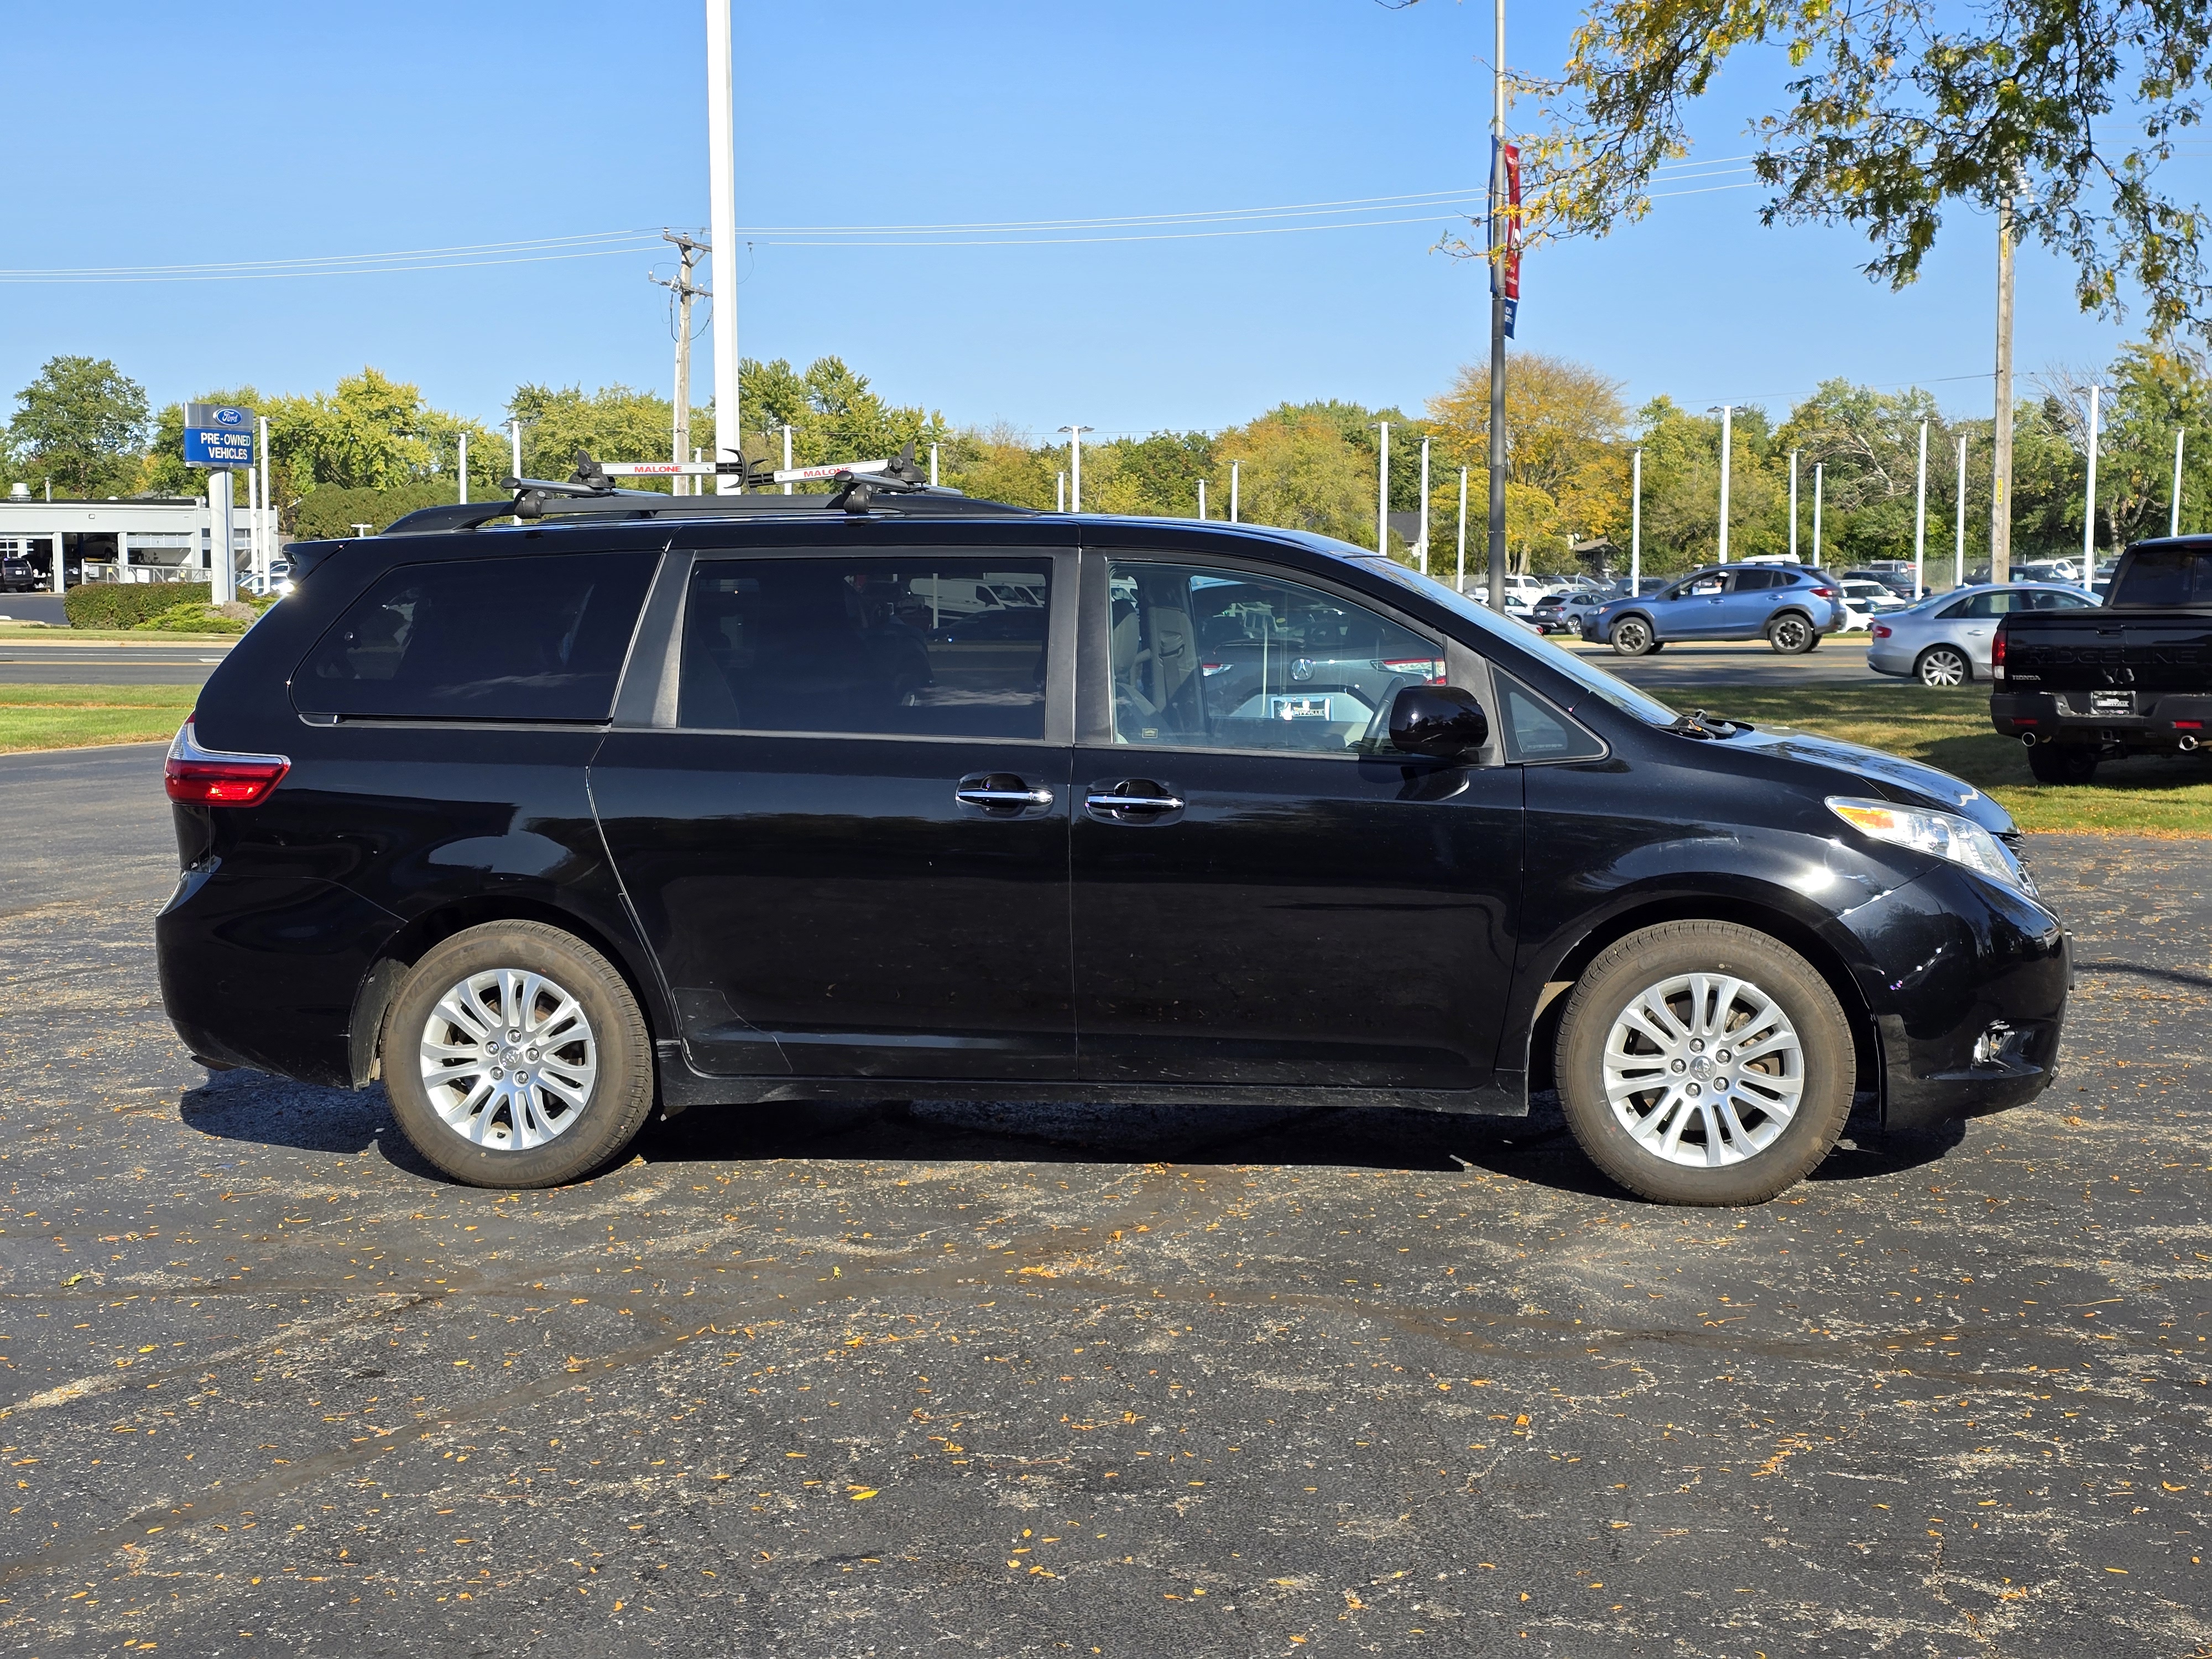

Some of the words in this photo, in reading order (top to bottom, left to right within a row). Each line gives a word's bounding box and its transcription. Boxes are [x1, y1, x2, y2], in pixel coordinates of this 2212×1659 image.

[222, 411, 238, 422] Ford
[201, 432, 251, 446] PRE-OWNED
[208, 446, 247, 460] VEHICLES
[2025, 649, 2198, 664] RIDGELINE
[501, 1143, 581, 1178] YOKOHAMA
